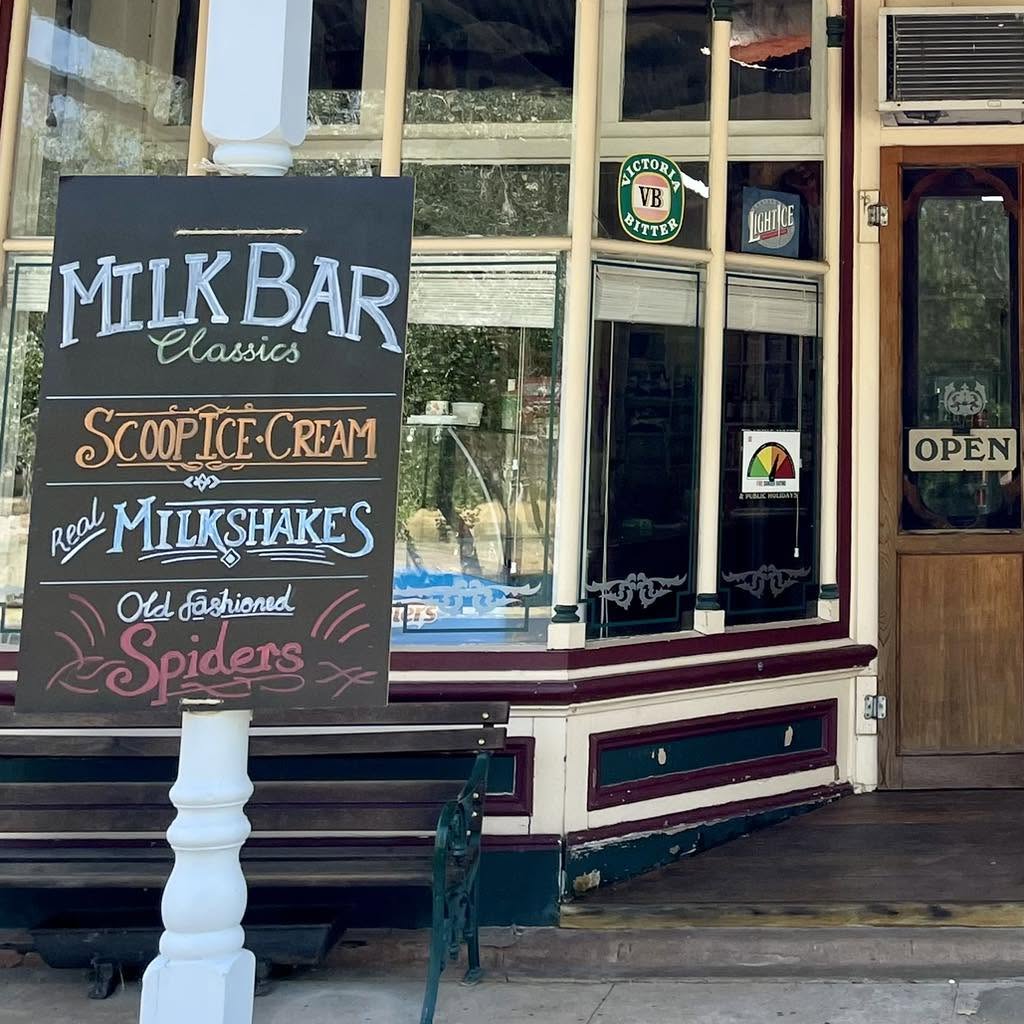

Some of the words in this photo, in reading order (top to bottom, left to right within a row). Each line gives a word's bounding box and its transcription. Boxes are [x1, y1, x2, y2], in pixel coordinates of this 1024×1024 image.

[622, 158, 680, 193] VICTORIA
[638, 186, 663, 208] VB
[624, 212, 679, 237] BITTER
[59, 250, 232, 348] MILK
[240, 242, 401, 353] BAR
[148, 328, 300, 365] Classics
[75, 407, 198, 468] SCOOP
[914, 437, 1011, 462] OPEN
[50, 497, 105, 557] Real
[106, 495, 374, 557] MILKSHAKES
[117, 590, 174, 624] Old
[106, 621, 304, 706] Spiders
